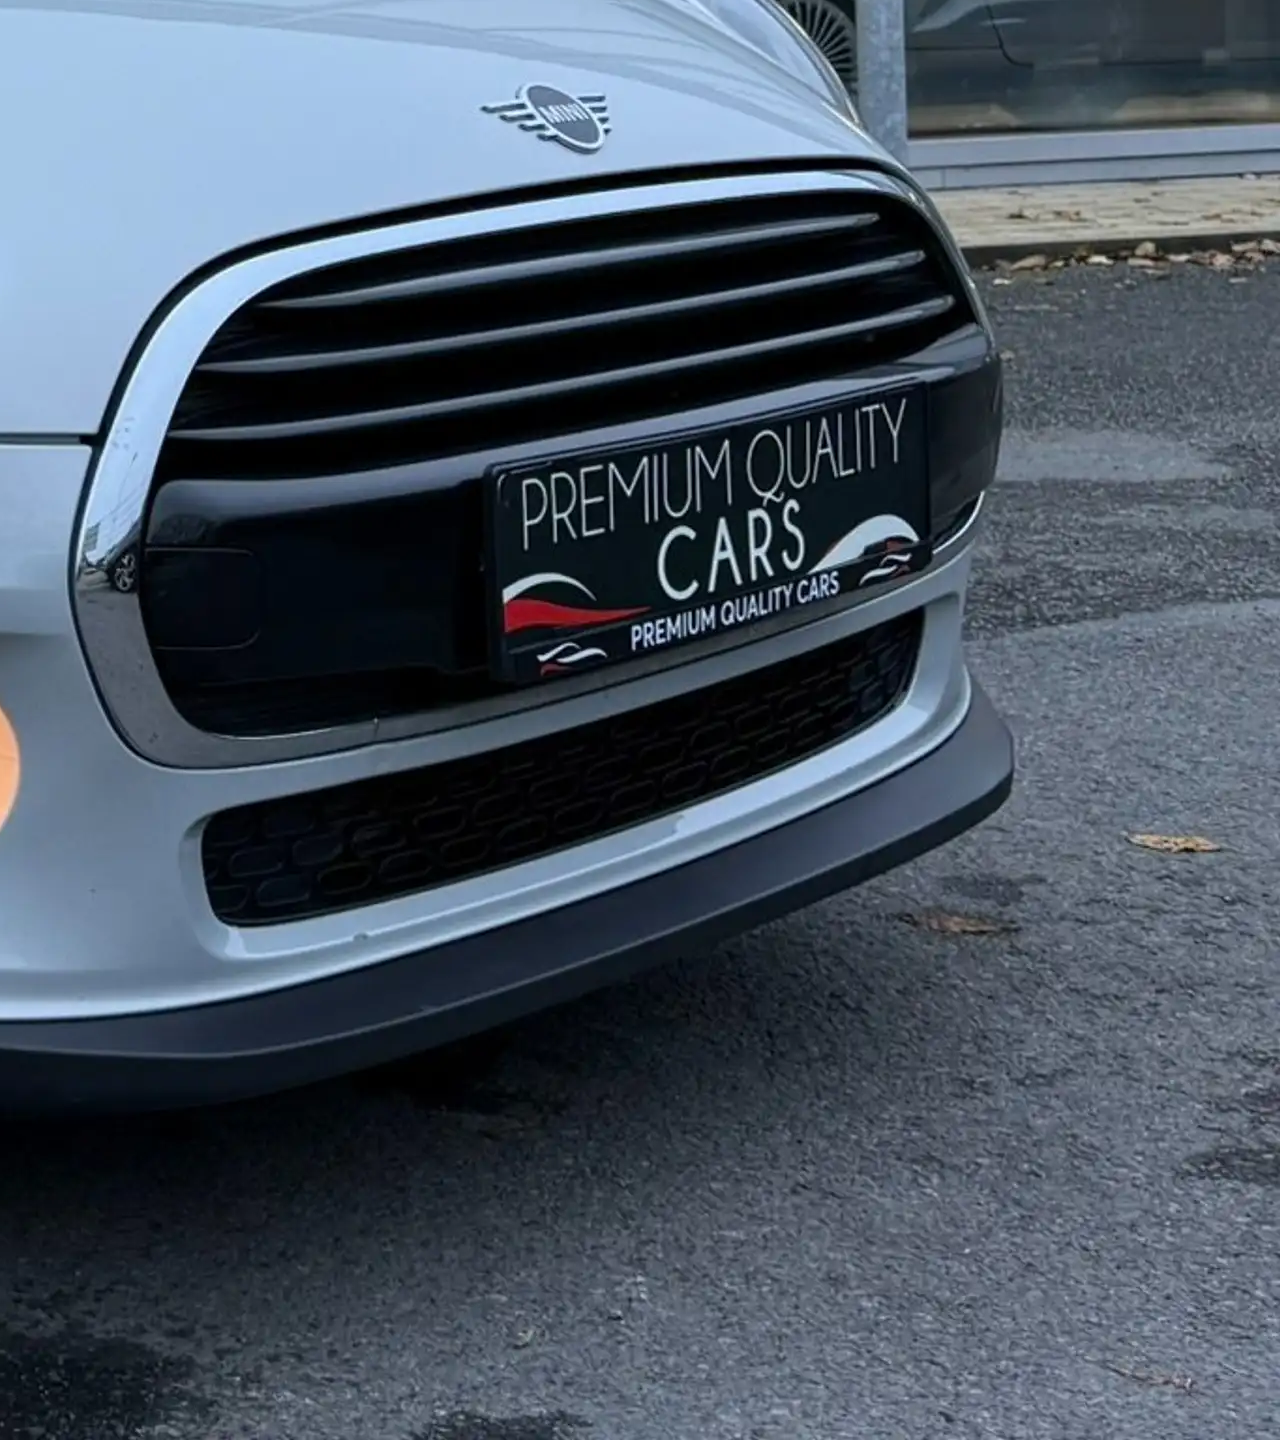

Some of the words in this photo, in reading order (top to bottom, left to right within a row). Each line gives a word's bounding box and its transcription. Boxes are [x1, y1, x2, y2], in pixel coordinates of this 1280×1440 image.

[538, 103, 589, 124] MINI
[521, 438, 732, 551] PREMIUM
[746, 398, 907, 507] QUALITY
[656, 498, 806, 601] CARS
[630, 609, 717, 651] PREMIUM
[720, 585, 794, 626] QUALITY
[795, 569, 840, 605] CARS
